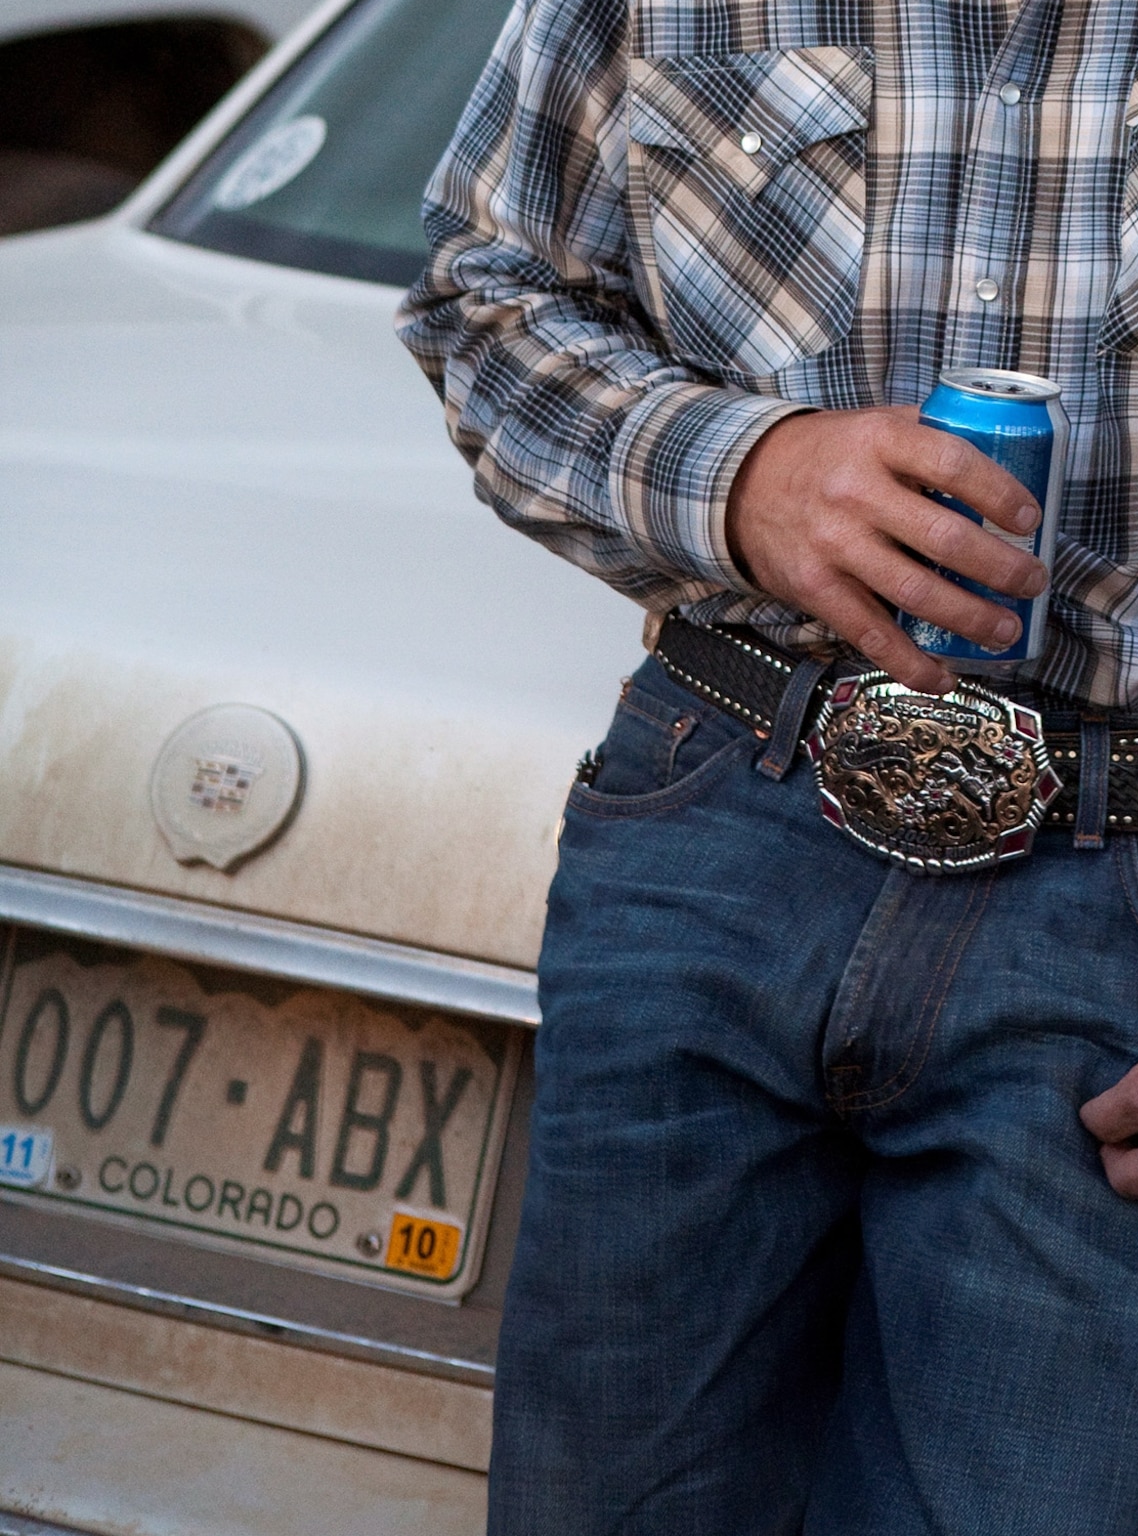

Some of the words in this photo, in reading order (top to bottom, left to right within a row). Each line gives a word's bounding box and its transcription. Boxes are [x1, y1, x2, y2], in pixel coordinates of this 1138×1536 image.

[881, 697, 978, 724] Association
[1, 1132, 34, 1169] 11
[99, 1156, 341, 1241] COLORADO
[399, 1221, 437, 1260] 10
